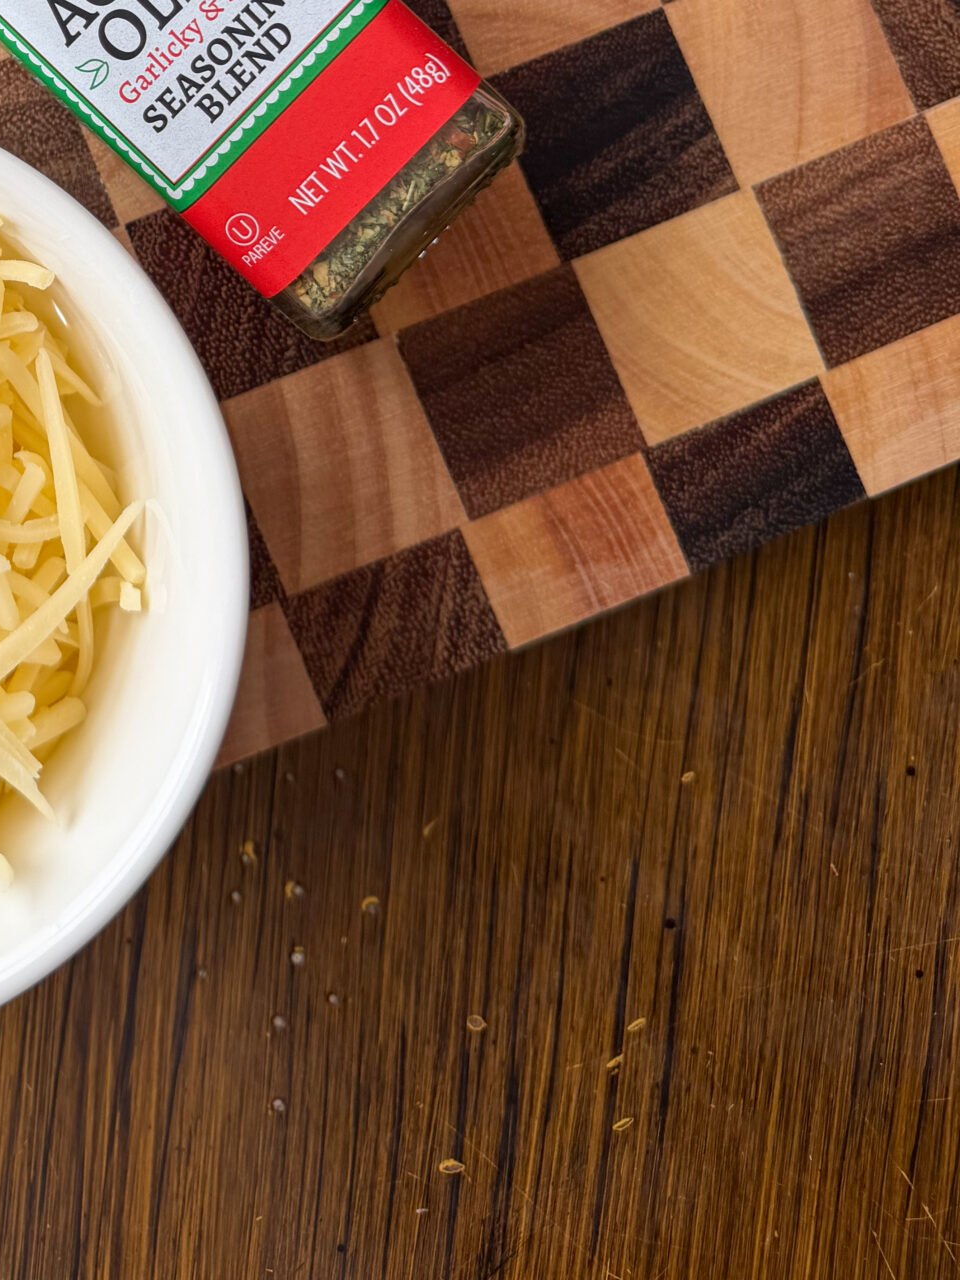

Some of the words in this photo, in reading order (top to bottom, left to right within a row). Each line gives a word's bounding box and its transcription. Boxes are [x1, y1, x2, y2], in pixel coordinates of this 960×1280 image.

[119, 18, 203, 105] Garlicky
[196, 22, 292, 123] BLEND
[288, 171, 330, 215] NET
[319, 140, 363, 181] WT.
[351, 119, 380, 149] 1.7
[374, 93, 408, 127] OZ
[396, 53, 451, 106] (48g)
[241, 225, 285, 268] PAREVE
